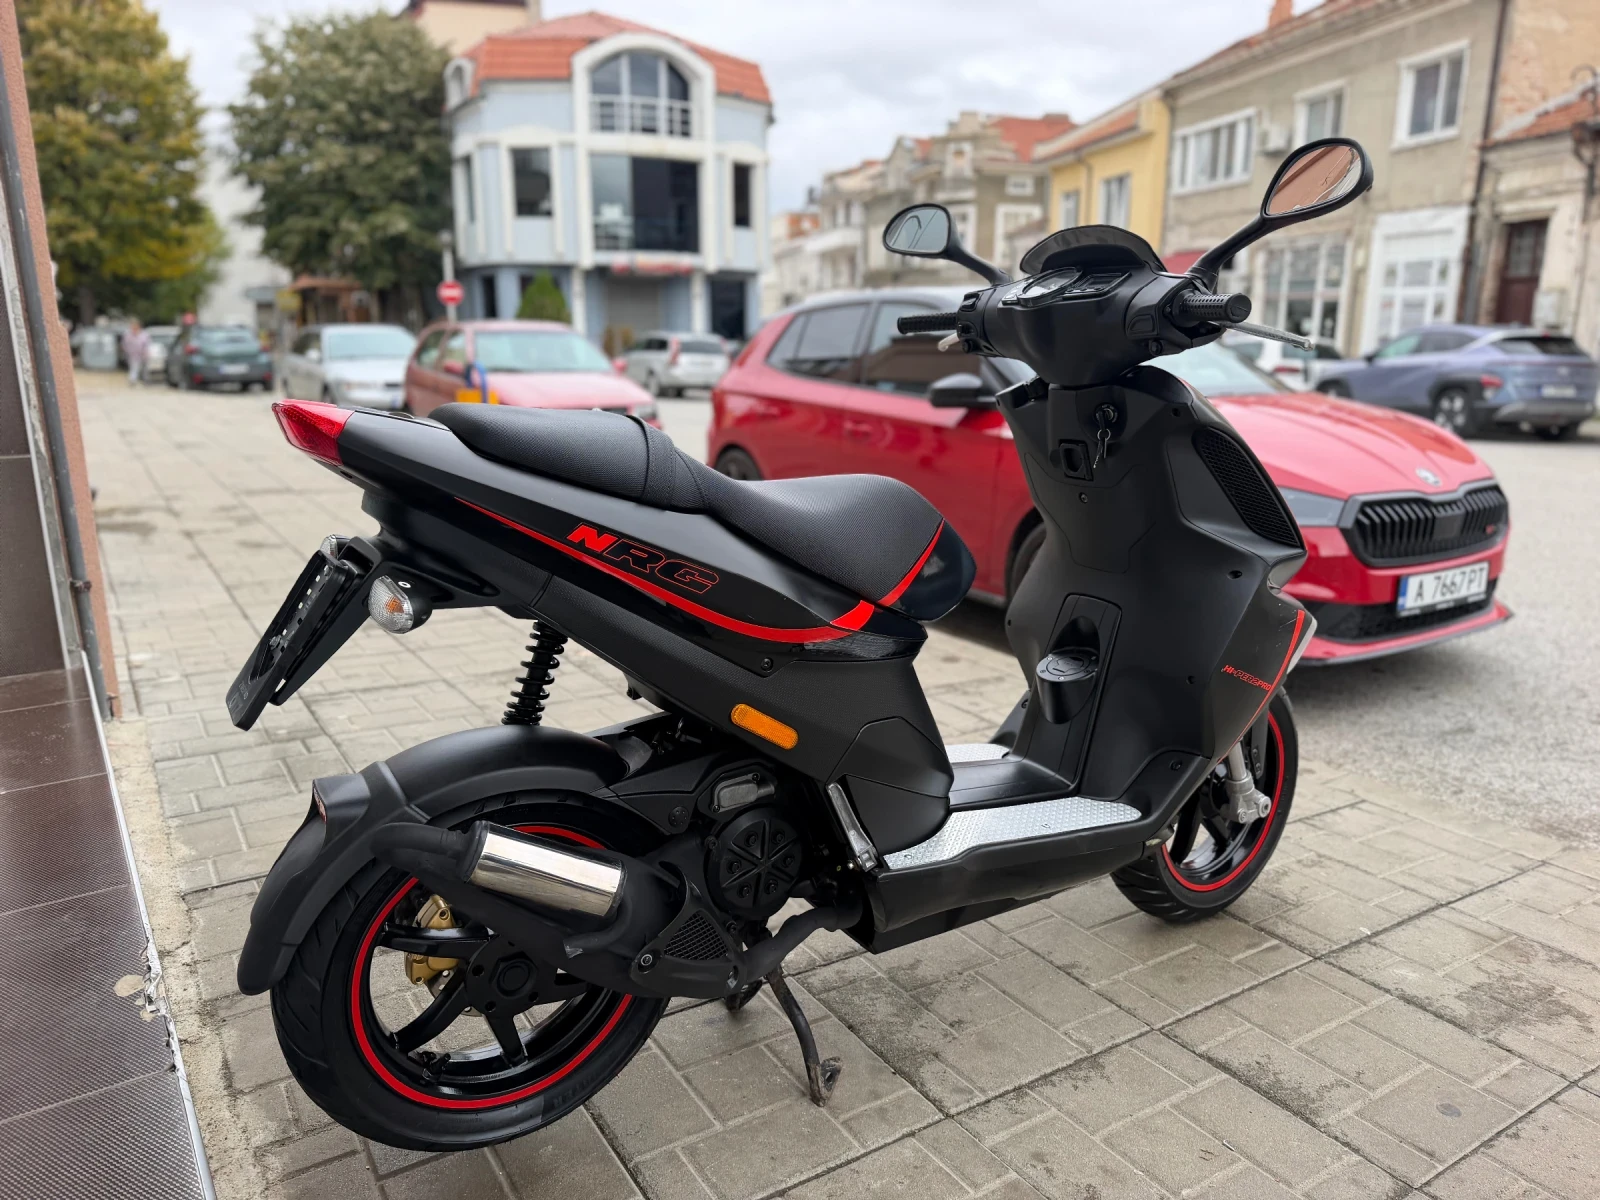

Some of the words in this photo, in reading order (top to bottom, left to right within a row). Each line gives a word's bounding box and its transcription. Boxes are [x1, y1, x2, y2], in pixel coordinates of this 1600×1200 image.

[566, 522, 719, 594] NRG
[1414, 579, 1424, 603] A
[1432, 567, 1486, 600] 7667PT
